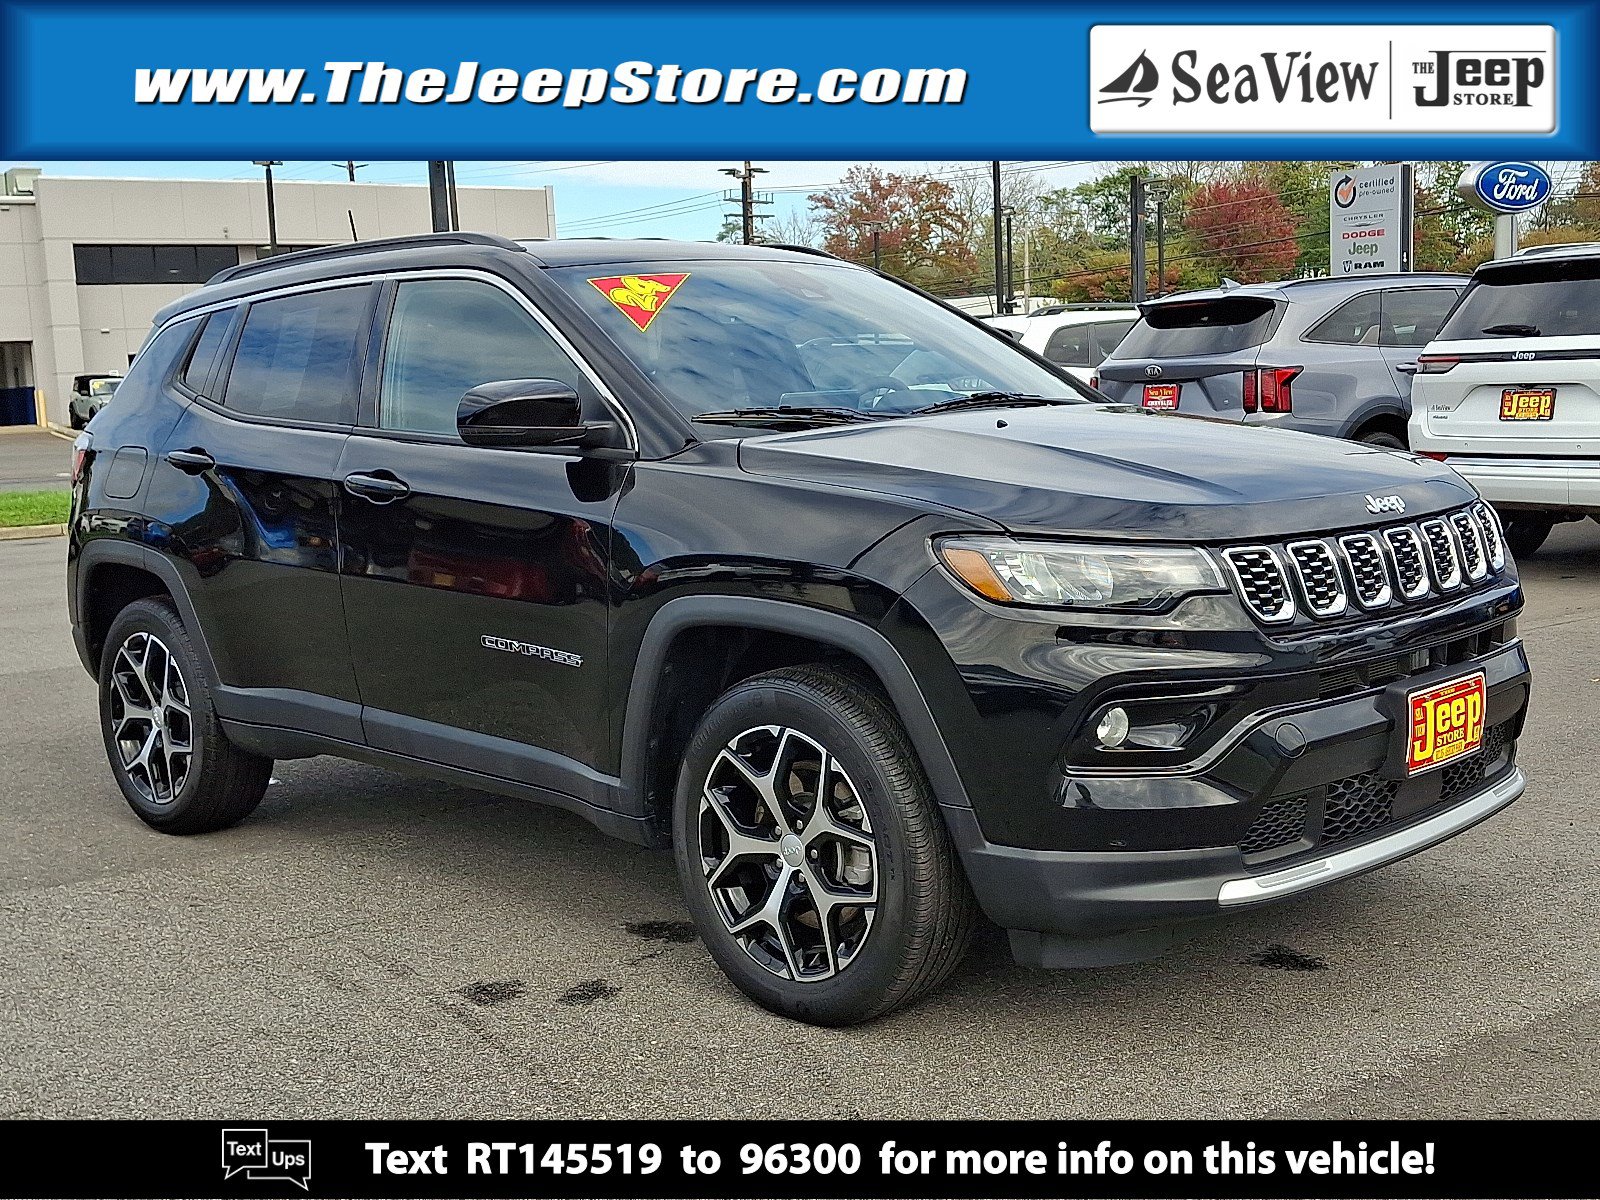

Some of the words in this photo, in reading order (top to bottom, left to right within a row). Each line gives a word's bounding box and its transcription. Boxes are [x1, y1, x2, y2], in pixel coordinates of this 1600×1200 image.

[1359, 176, 1395, 189] certified
[1493, 168, 1540, 201] Ford
[1358, 187, 1395, 198] pre-owned
[1343, 213, 1384, 222] CHRYSLER
[1342, 229, 1385, 240] DODGE
[1348, 242, 1379, 257] Jeep
[1354, 261, 1385, 270] RAM
[1512, 351, 1536, 361] Jeep
[1503, 393, 1551, 416] Jeep
[1364, 494, 1406, 514] Jeep
[481, 635, 583, 668] COMPASS
[1413, 691, 1481, 762] Jeep
[1436, 728, 1465, 747] STORE
